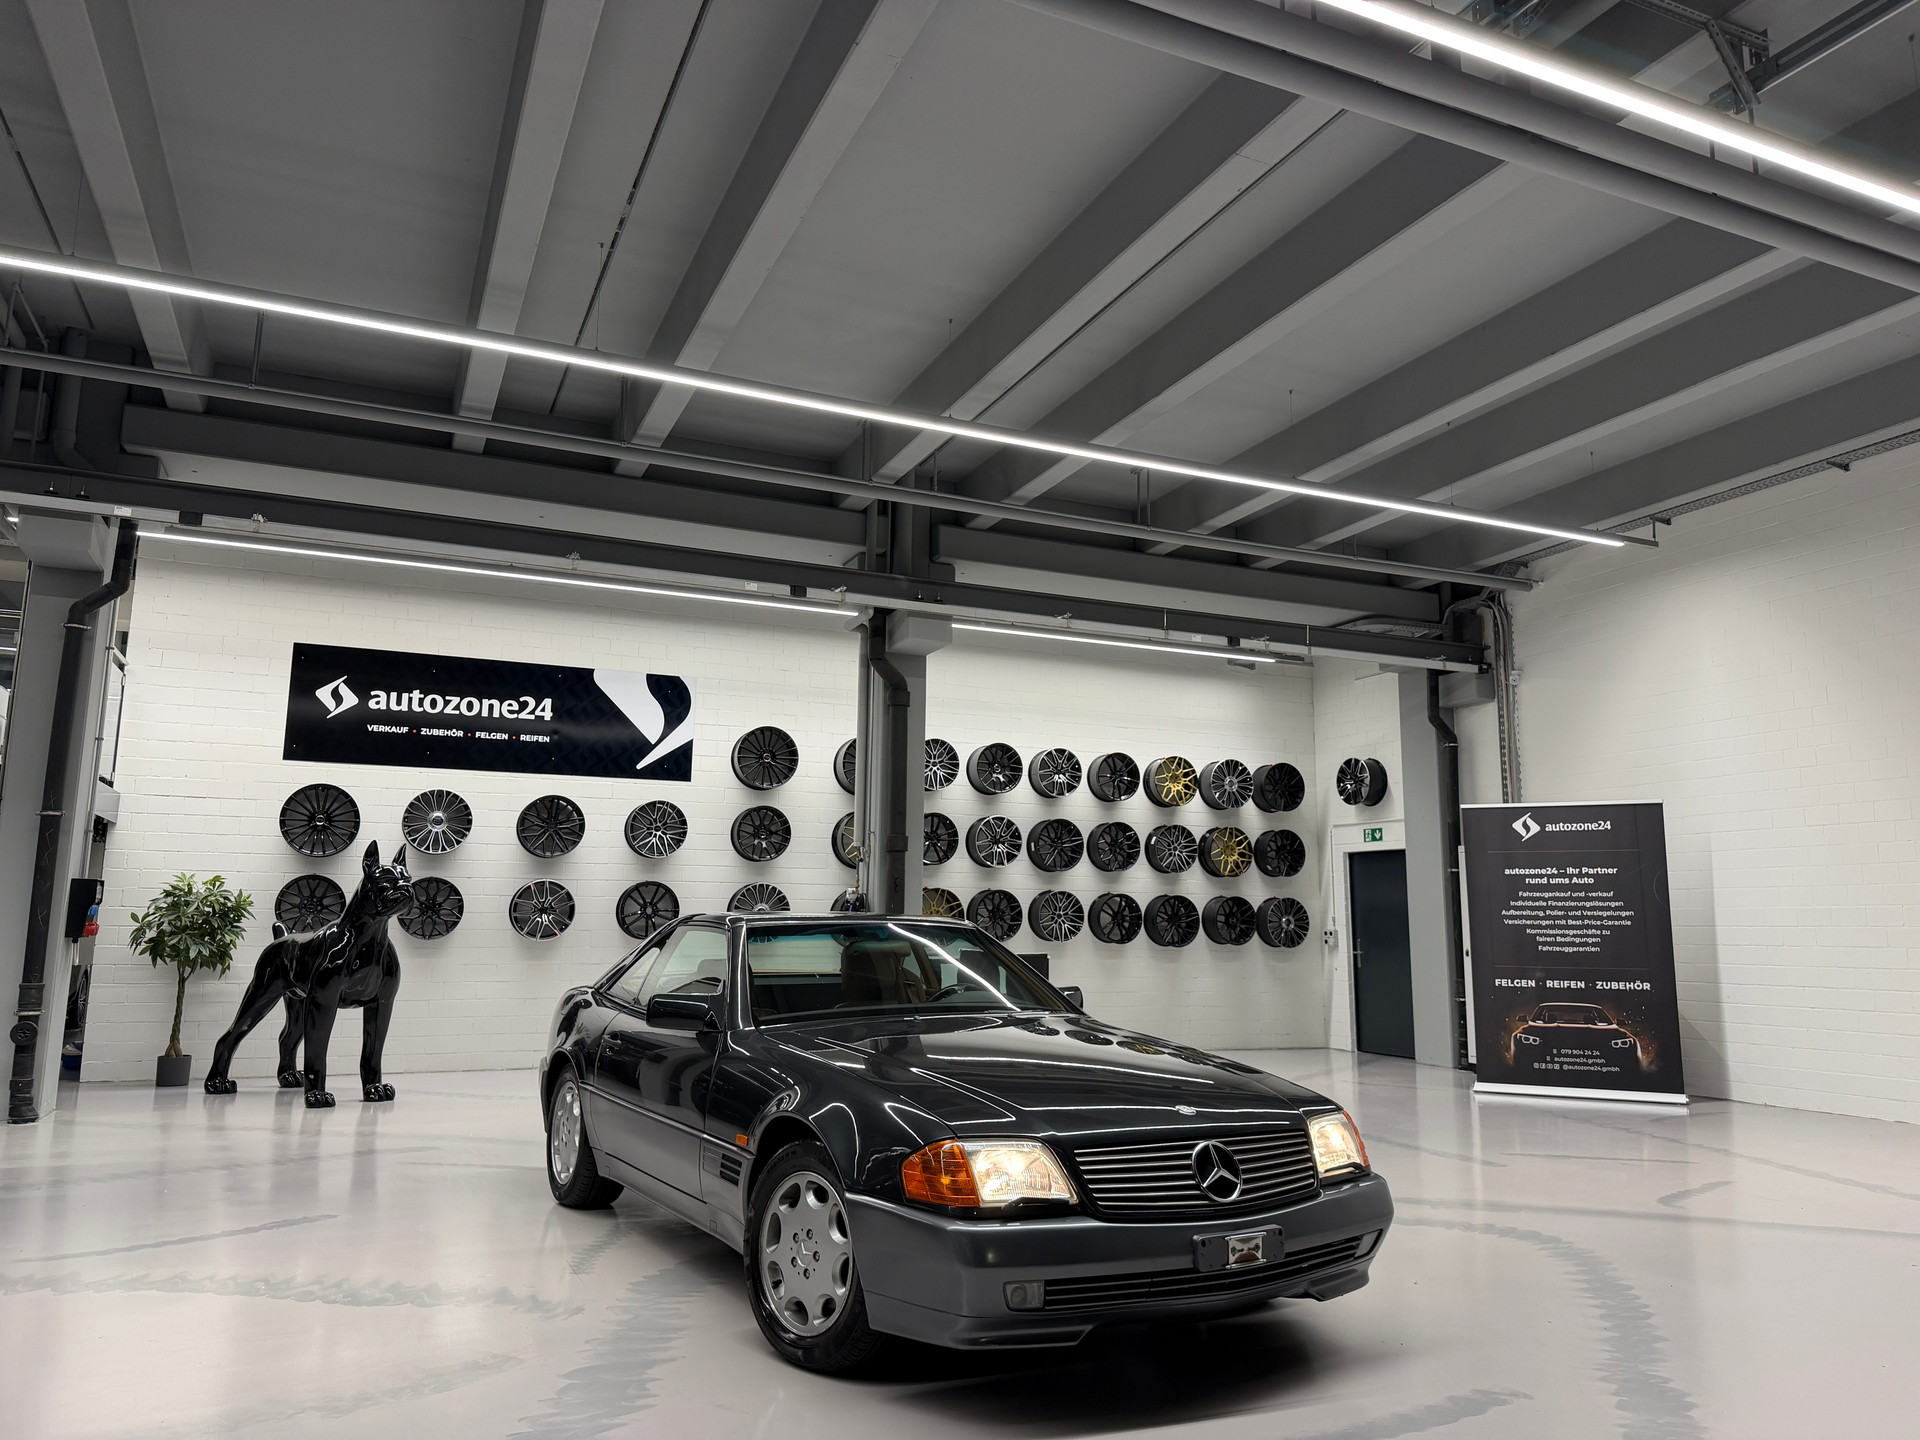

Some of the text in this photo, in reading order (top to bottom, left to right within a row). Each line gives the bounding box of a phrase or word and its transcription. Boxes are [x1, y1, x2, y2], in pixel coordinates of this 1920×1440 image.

[367, 689, 553, 721] autozone24
[367, 724, 550, 743] VERKAUF ZUBEHÖR FELGEN REIFEN
[1545, 820, 1612, 832] autozone24
[1504, 867, 1558, 875] autozone24
[1566, 866, 1580, 874] Ihr
[1525, 876, 1548, 884] rund
[1571, 876, 1595, 884] Auto
[1547, 900, 1624, 908] Finanzierungslösungen
[1503, 918, 1554, 926] Versicherungen
[1556, 936, 1602, 944] Bedingungen
[1538, 945, 1601, 953] Fahrzeuggarantien
[1494, 978, 1652, 991] FELGEN REIFEN ZUBEHÖR
